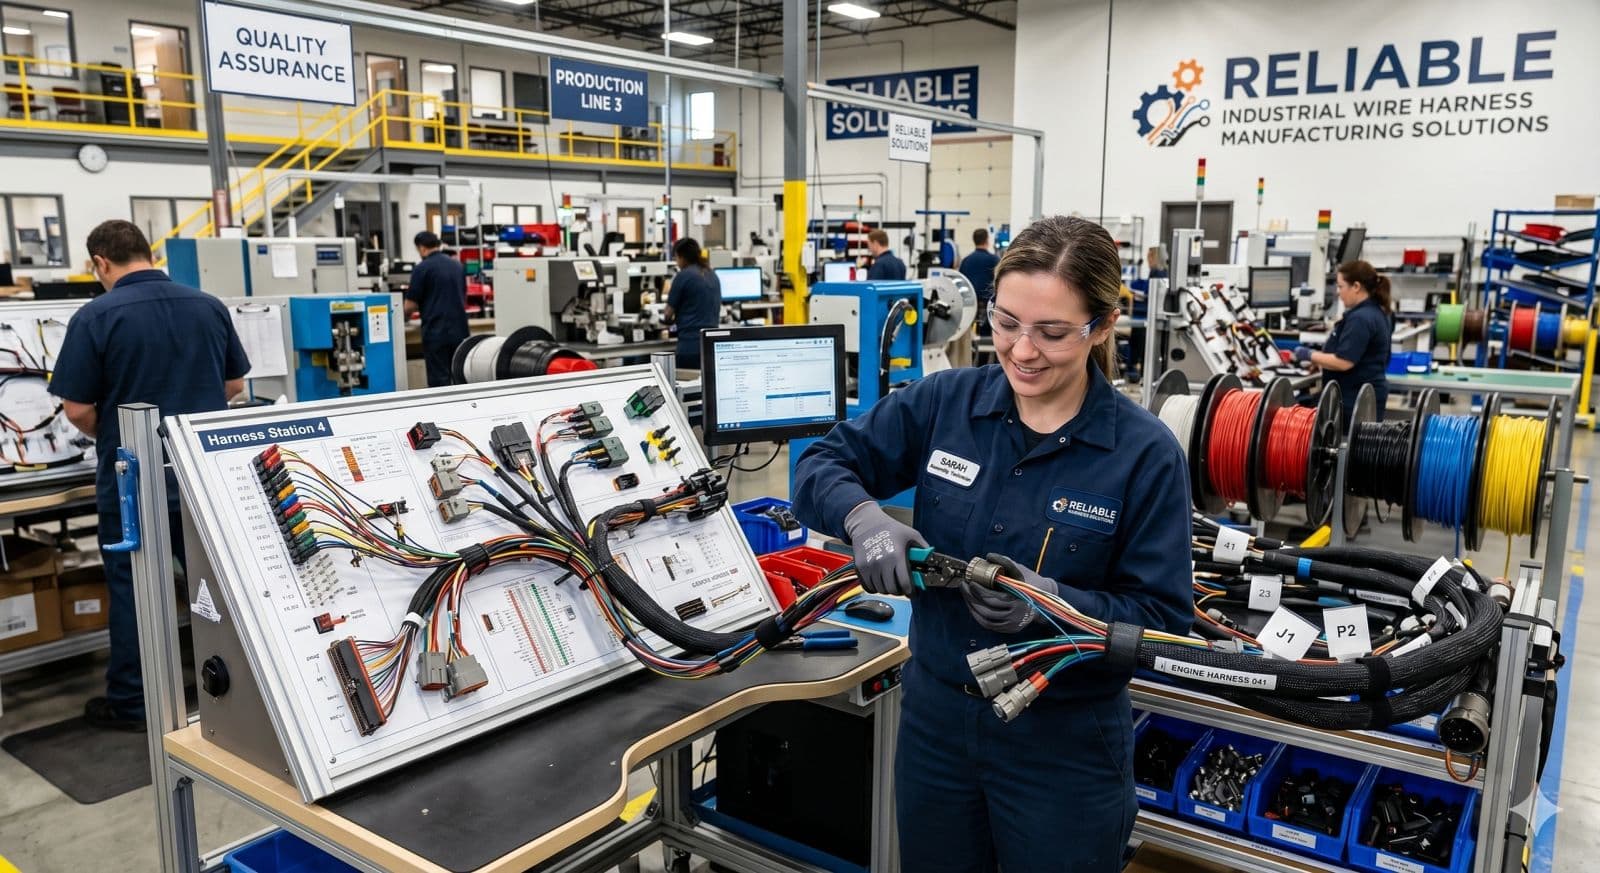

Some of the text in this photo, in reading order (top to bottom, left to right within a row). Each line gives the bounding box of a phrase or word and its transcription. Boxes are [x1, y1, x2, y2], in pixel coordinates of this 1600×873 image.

[236, 27, 327, 56] QUALITY
[219, 51, 346, 83] ASSURANCE
[1224, 30, 1557, 100] RELIABLE
[556, 69, 644, 96] PRODUCTION
[581, 93, 623, 113] LINE 3
[1223, 92, 1533, 124] INDUSTRIAL WIRE HARNESS
[895, 124, 926, 138] RELIABLE
[1221, 115, 1549, 146] MANUFACTURING SOLUTIONS
[891, 137, 929, 152] SOLUTIONS
[207, 422, 326, 446] Harness Station 4
[940, 457, 968, 473] SARAH
[1069, 500, 1117, 519] RELIABLE
[1224, 541, 1236, 551] 41
[1259, 589, 1271, 598] 23
[1276, 628, 1295, 643] J1
[1337, 624, 1357, 638] P2
[1171, 664, 1267, 686] ENGINE HARNESS 041
